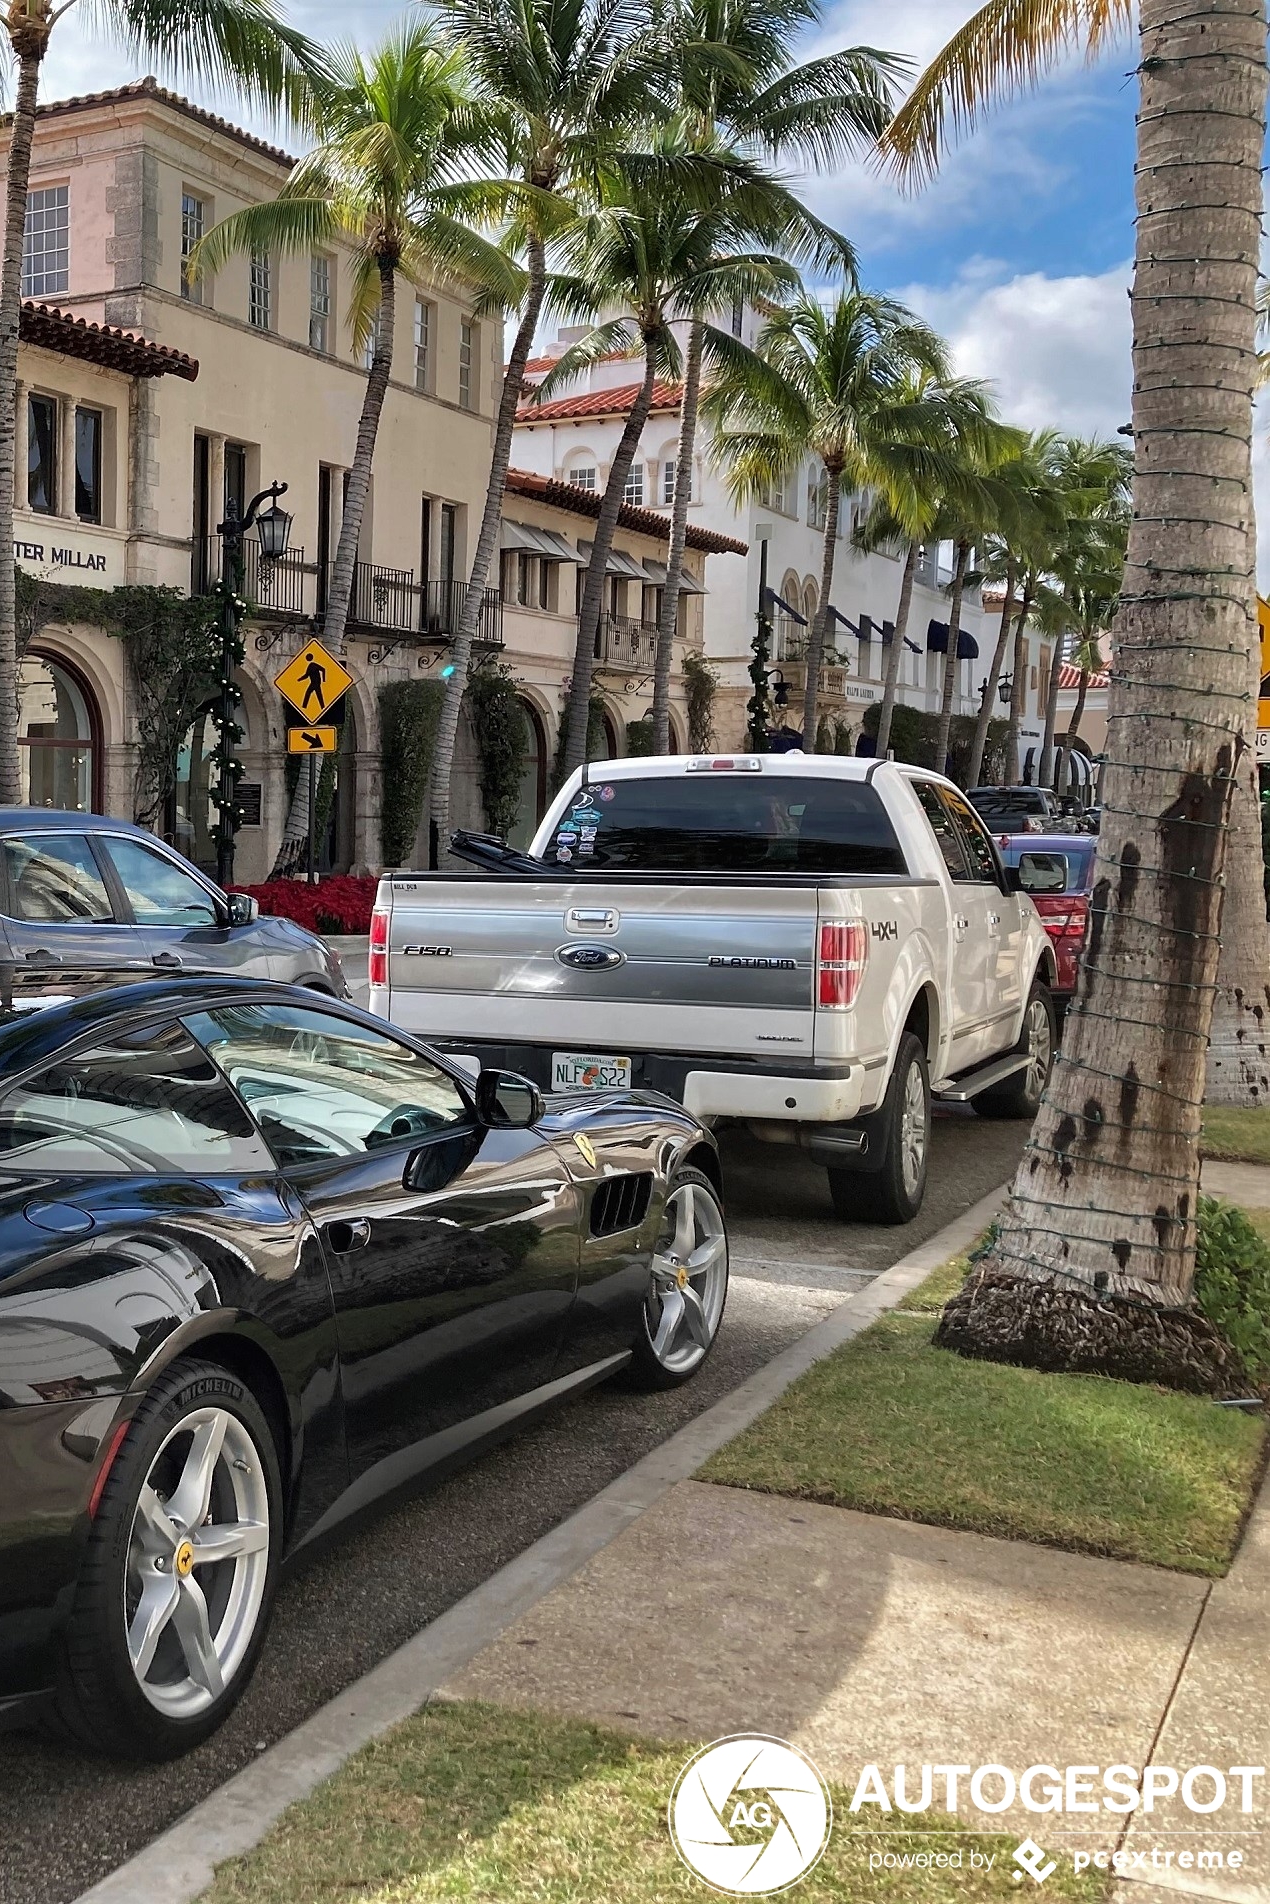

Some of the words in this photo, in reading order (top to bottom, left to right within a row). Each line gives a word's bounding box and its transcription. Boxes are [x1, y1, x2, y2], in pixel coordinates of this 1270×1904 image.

[51, 547, 106, 571] MILLAR
[871, 920, 898, 942] 4X4
[574, 950, 599, 964] Ford
[708, 956, 796, 970] PLATINUM
[180, 1378, 243, 1404] MICHELIN
